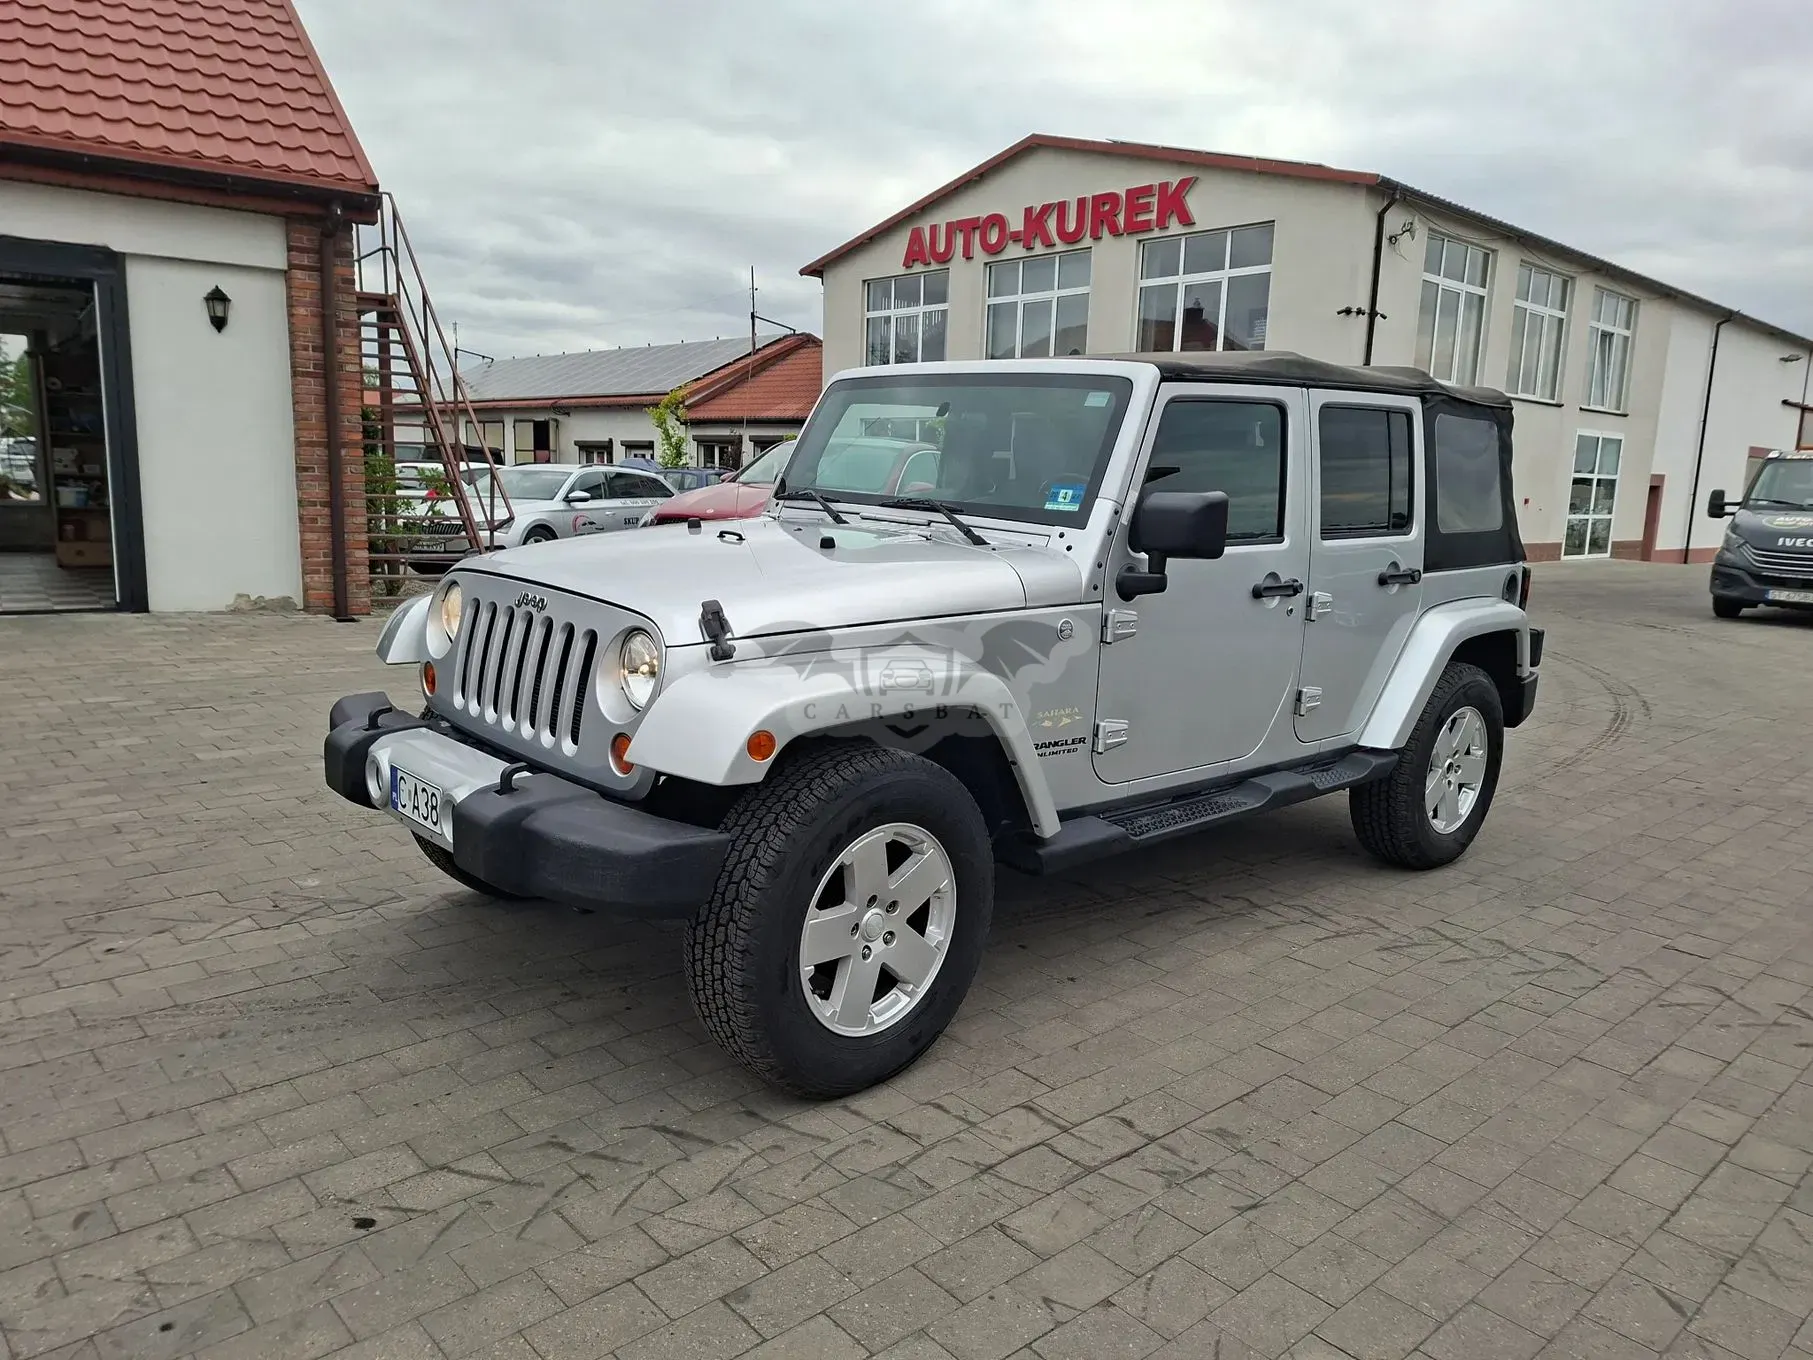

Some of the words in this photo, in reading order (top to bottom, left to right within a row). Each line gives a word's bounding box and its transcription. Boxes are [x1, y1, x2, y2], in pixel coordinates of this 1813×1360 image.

[902, 175, 1198, 268] AUTO-KUREK
[1777, 537, 1813, 547] IVEC
[514, 591, 549, 613] Jeep
[1036, 706, 1079, 718] SAHARA
[1033, 736, 1087, 750] RANGLER
[1037, 747, 1078, 757] NLIMITED
[412, 782, 439, 827] A38
